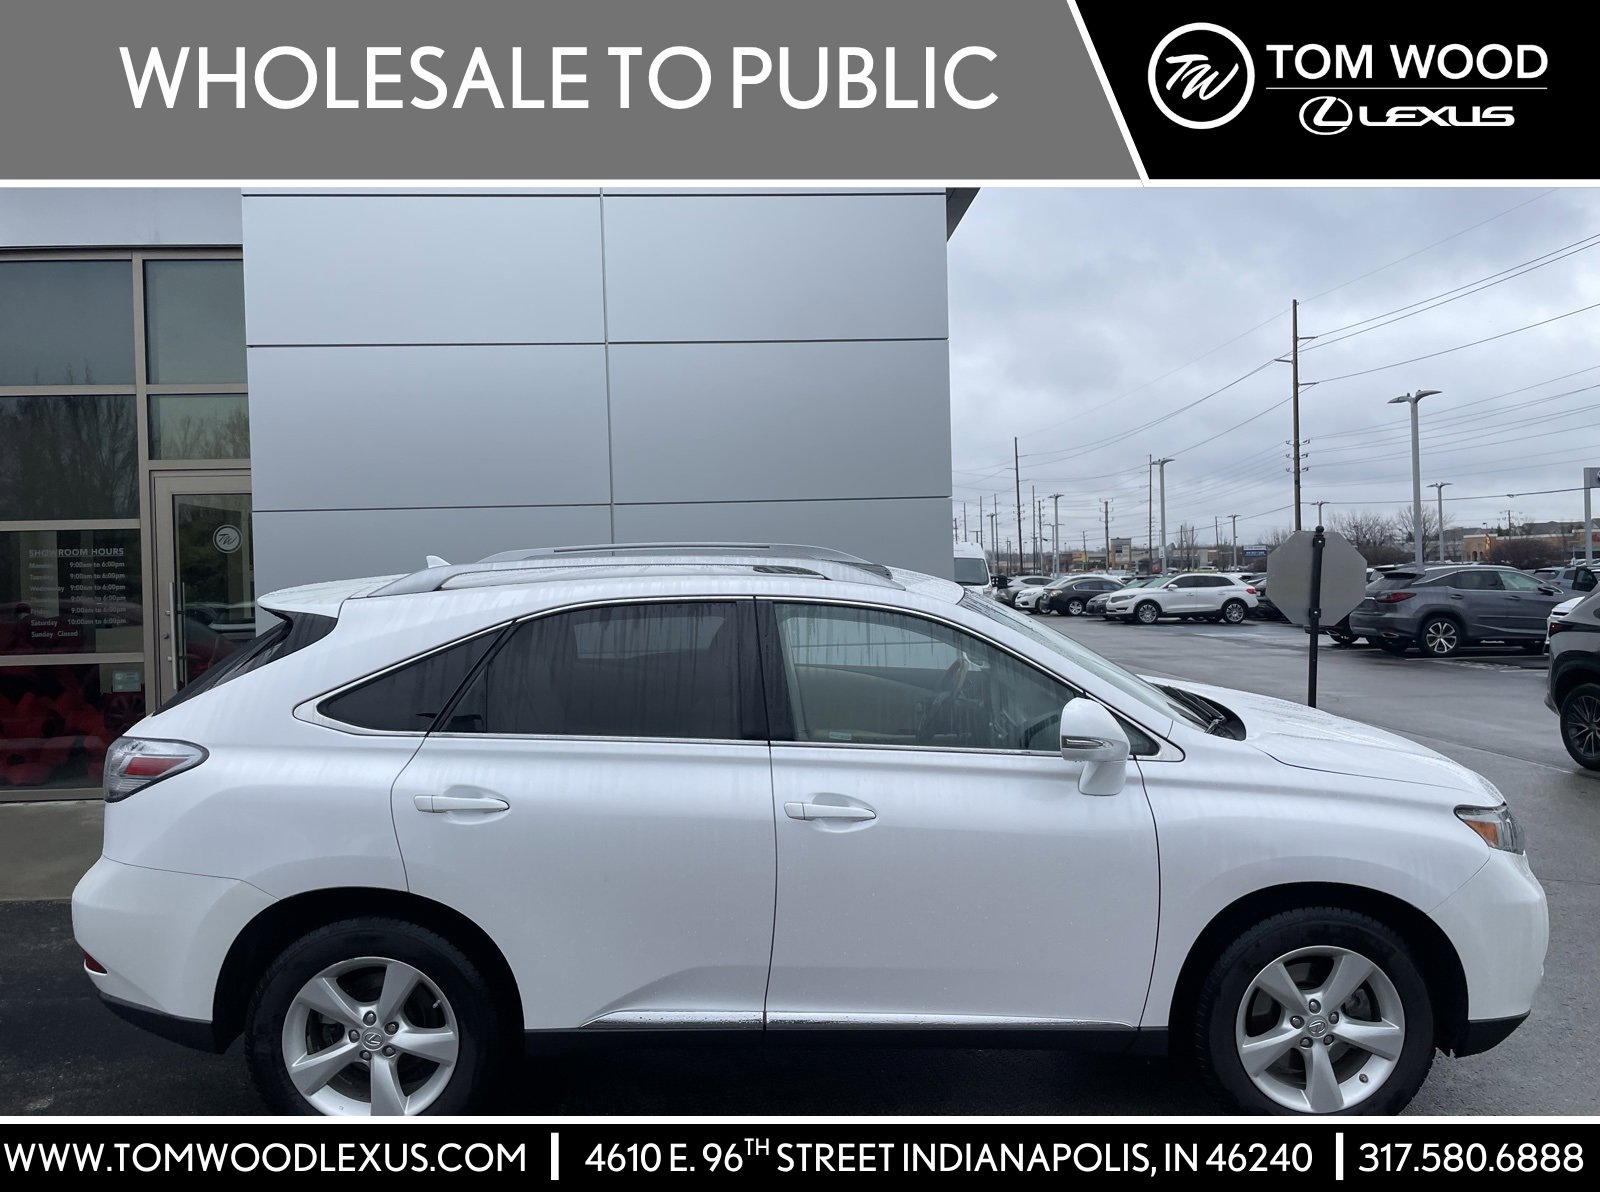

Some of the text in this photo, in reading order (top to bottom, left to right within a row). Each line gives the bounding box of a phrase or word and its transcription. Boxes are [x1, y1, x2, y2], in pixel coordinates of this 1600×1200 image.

[101, 561, 125, 569] 6:00pm
[101, 572, 125, 580] 6:00pm
[101, 583, 125, 591] 6:00pm
[30, 619, 58, 627] Saturday
